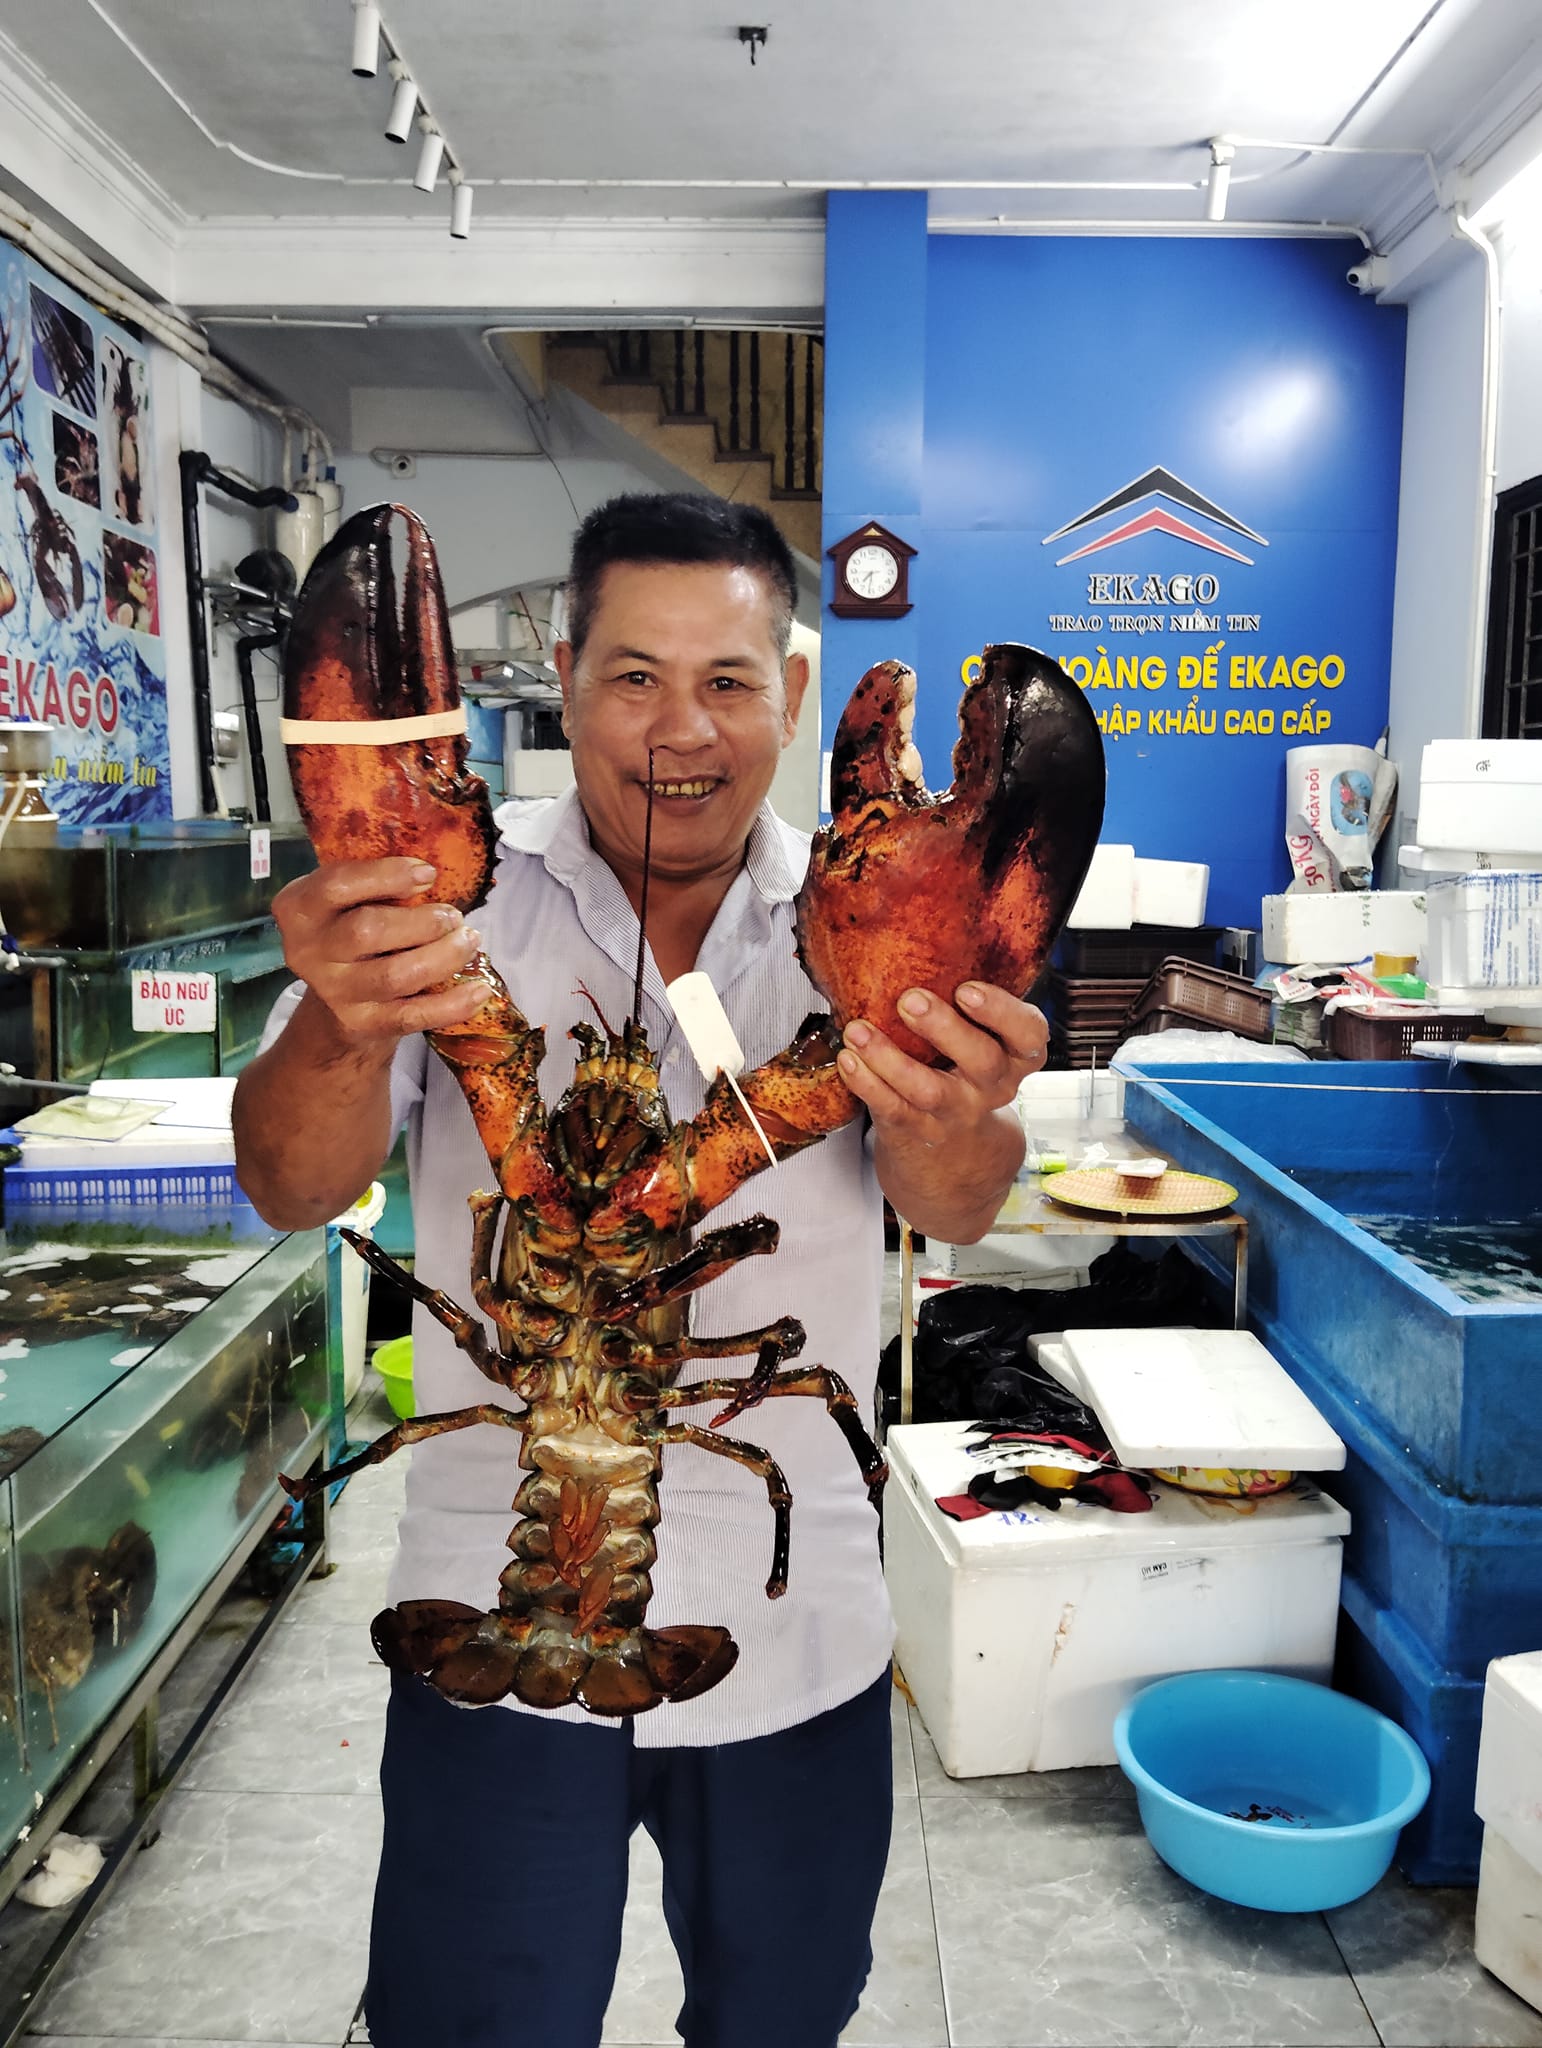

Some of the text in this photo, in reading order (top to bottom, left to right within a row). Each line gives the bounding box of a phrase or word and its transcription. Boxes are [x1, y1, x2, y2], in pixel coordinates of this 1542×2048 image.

[1088, 573, 1220, 605] EKAGO
[1049, 614, 1103, 632] TRAO
[1109, 614, 1165, 636] TRỌN
[1226, 614, 1261, 632] TIN
[1058, 640, 1346, 690] OÀNG ĐẾ EKAGO
[1094, 694, 1332, 741] HẬP KHẨU CAO CẤP
[177, 981, 209, 1000] NGƯ
